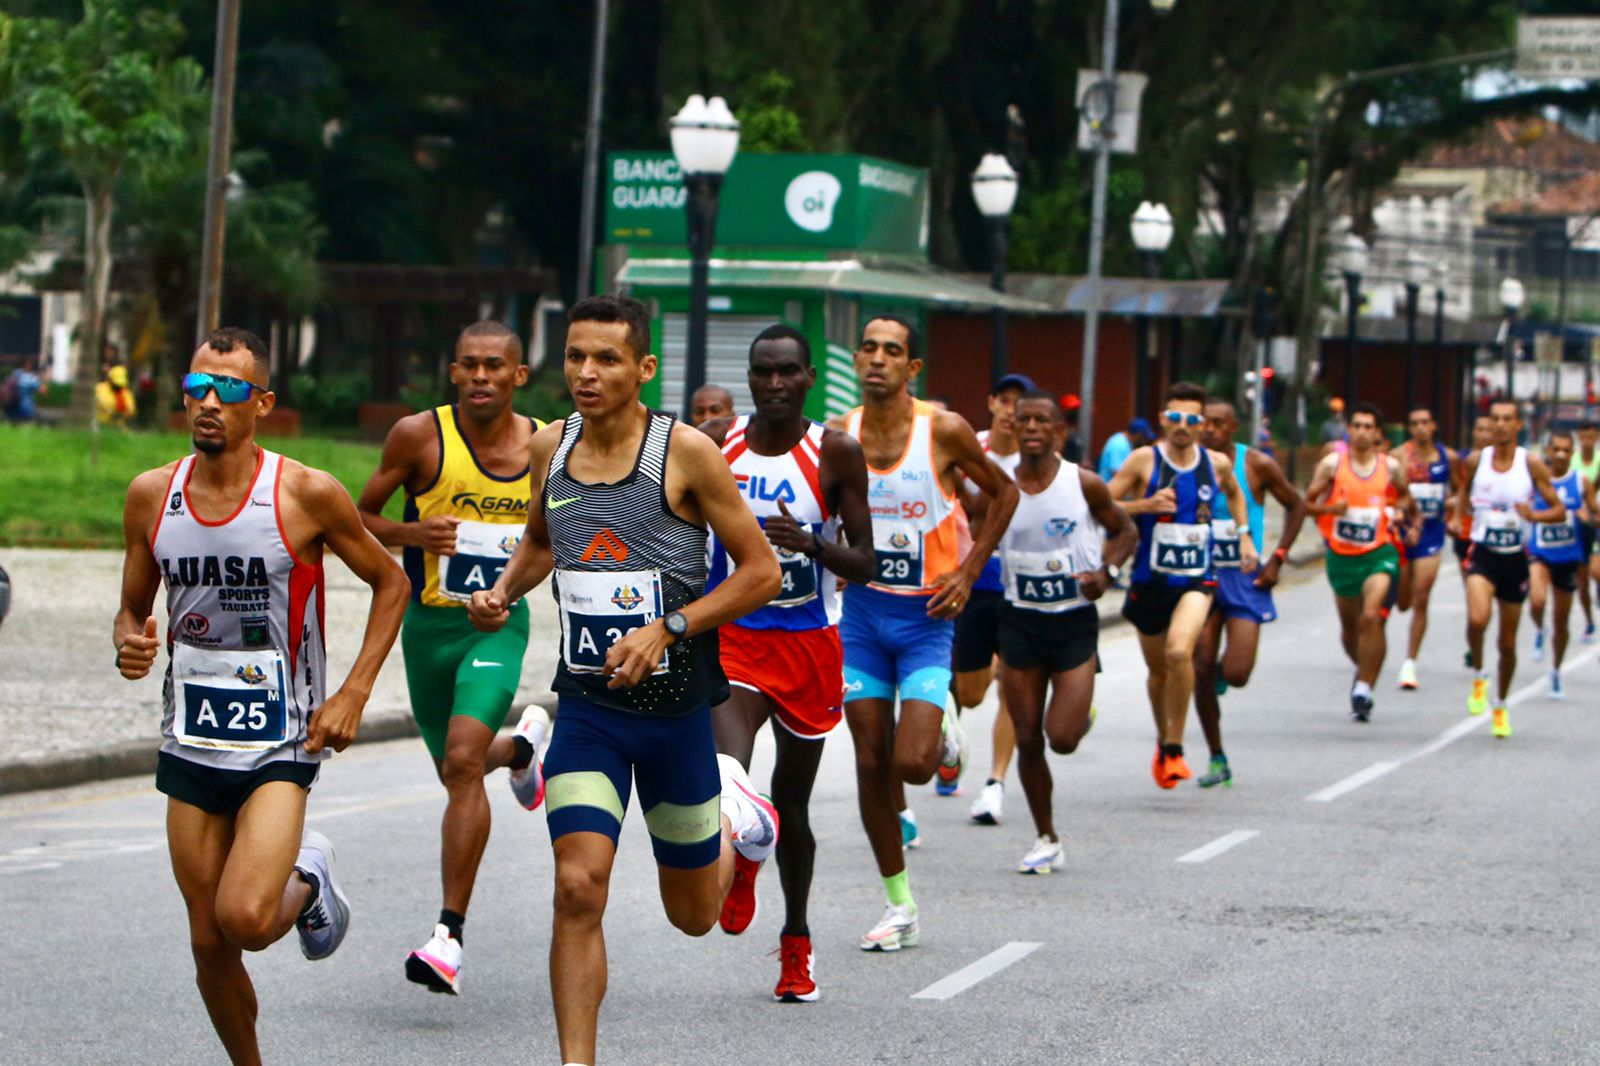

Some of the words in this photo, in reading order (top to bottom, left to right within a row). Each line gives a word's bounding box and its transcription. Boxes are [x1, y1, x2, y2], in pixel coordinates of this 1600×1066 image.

[803, 191, 825, 213] oi
[733, 475, 795, 503] FILA
[901, 502, 927, 519] 50
[1162, 549, 1177, 564] A
[1181, 549, 1198, 565] 11
[1213, 544, 1224, 558] A
[162, 556, 268, 587] LUASA
[464, 564, 486, 588] A
[881, 559, 909, 579] 29
[218, 588, 270, 600] SPORTS
[1024, 580, 1039, 598] A
[1041, 580, 1065, 598] 31
[577, 626, 599, 656] A
[644, 612, 656, 625] M
[196, 698, 219, 729] A
[227, 701, 267, 730] 25
[267, 690, 280, 701] M
